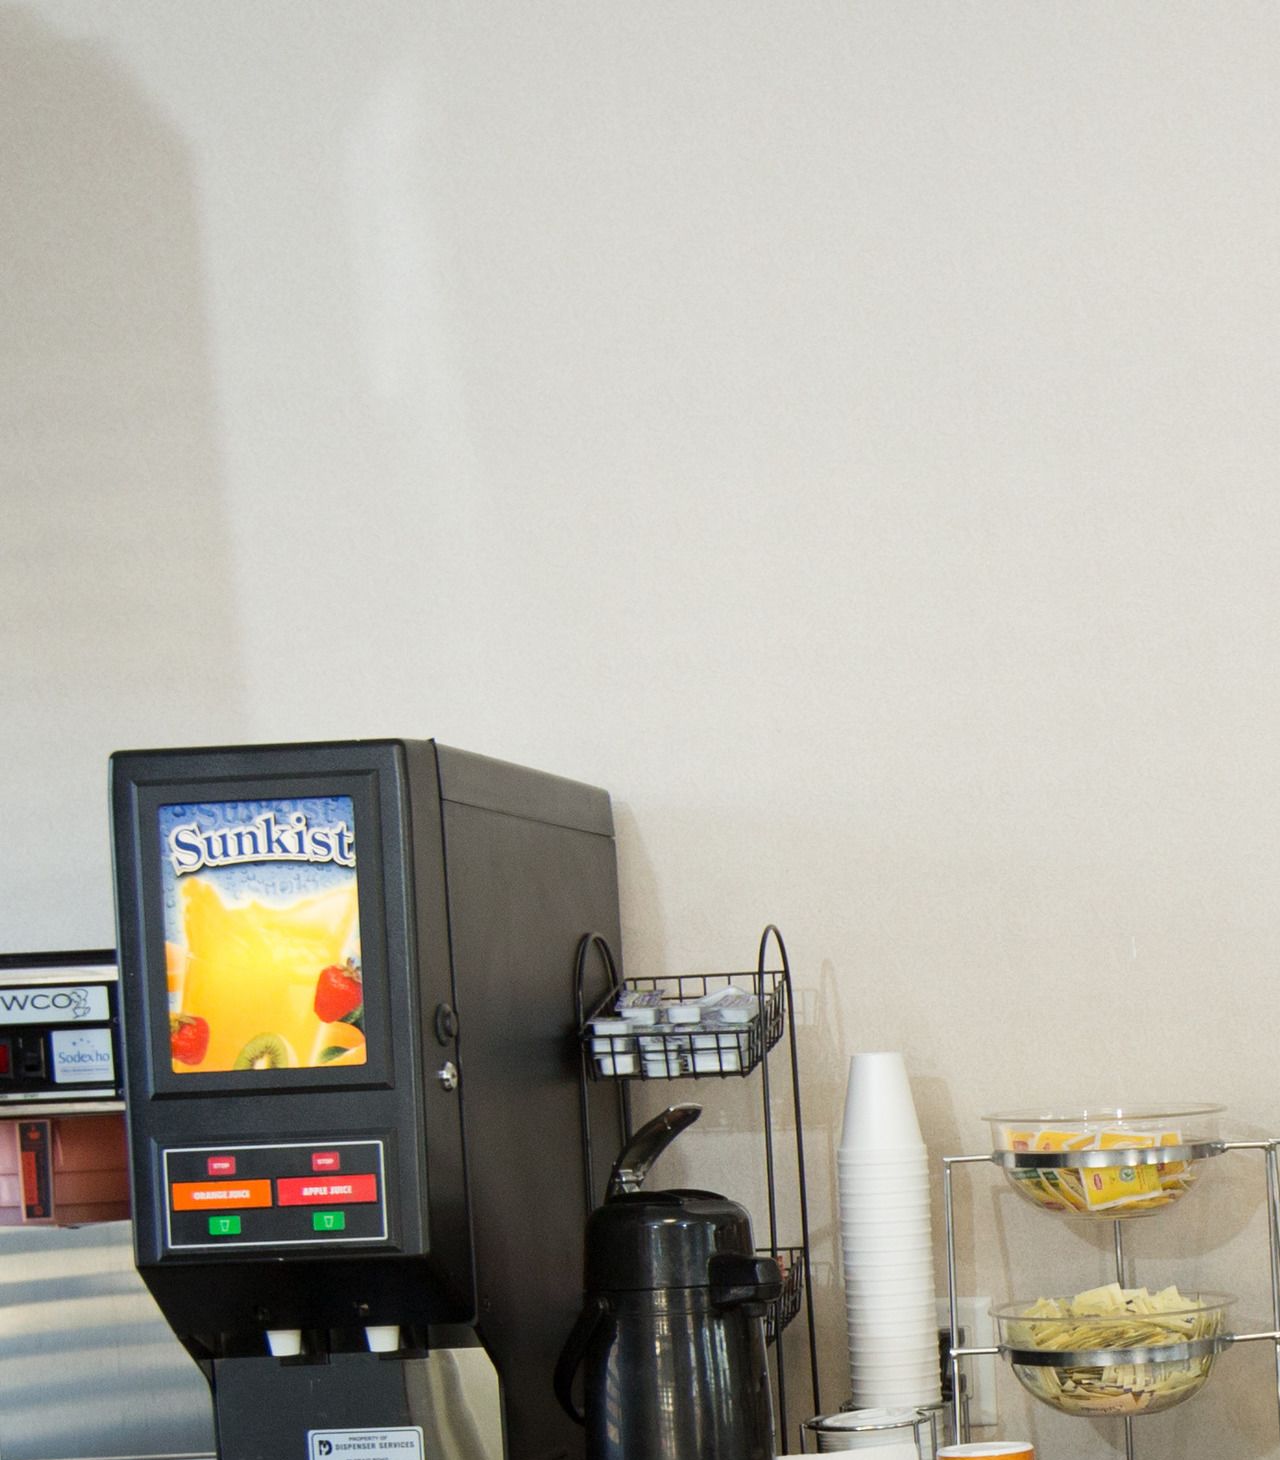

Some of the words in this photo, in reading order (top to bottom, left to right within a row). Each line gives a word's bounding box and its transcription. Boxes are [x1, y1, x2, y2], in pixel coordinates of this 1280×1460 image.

[171, 814, 355, 873] Sunkist
[58, 1050, 110, 1064] Sodexho
[193, 1191, 227, 1200] ORANGE
[227, 1189, 250, 1199] JUICE
[302, 1187, 328, 1197] APPLE
[329, 1185, 352, 1195] JUICE
[335, 1442, 376, 1451] DISPENSER
[379, 1441, 415, 1449] SERVICES
